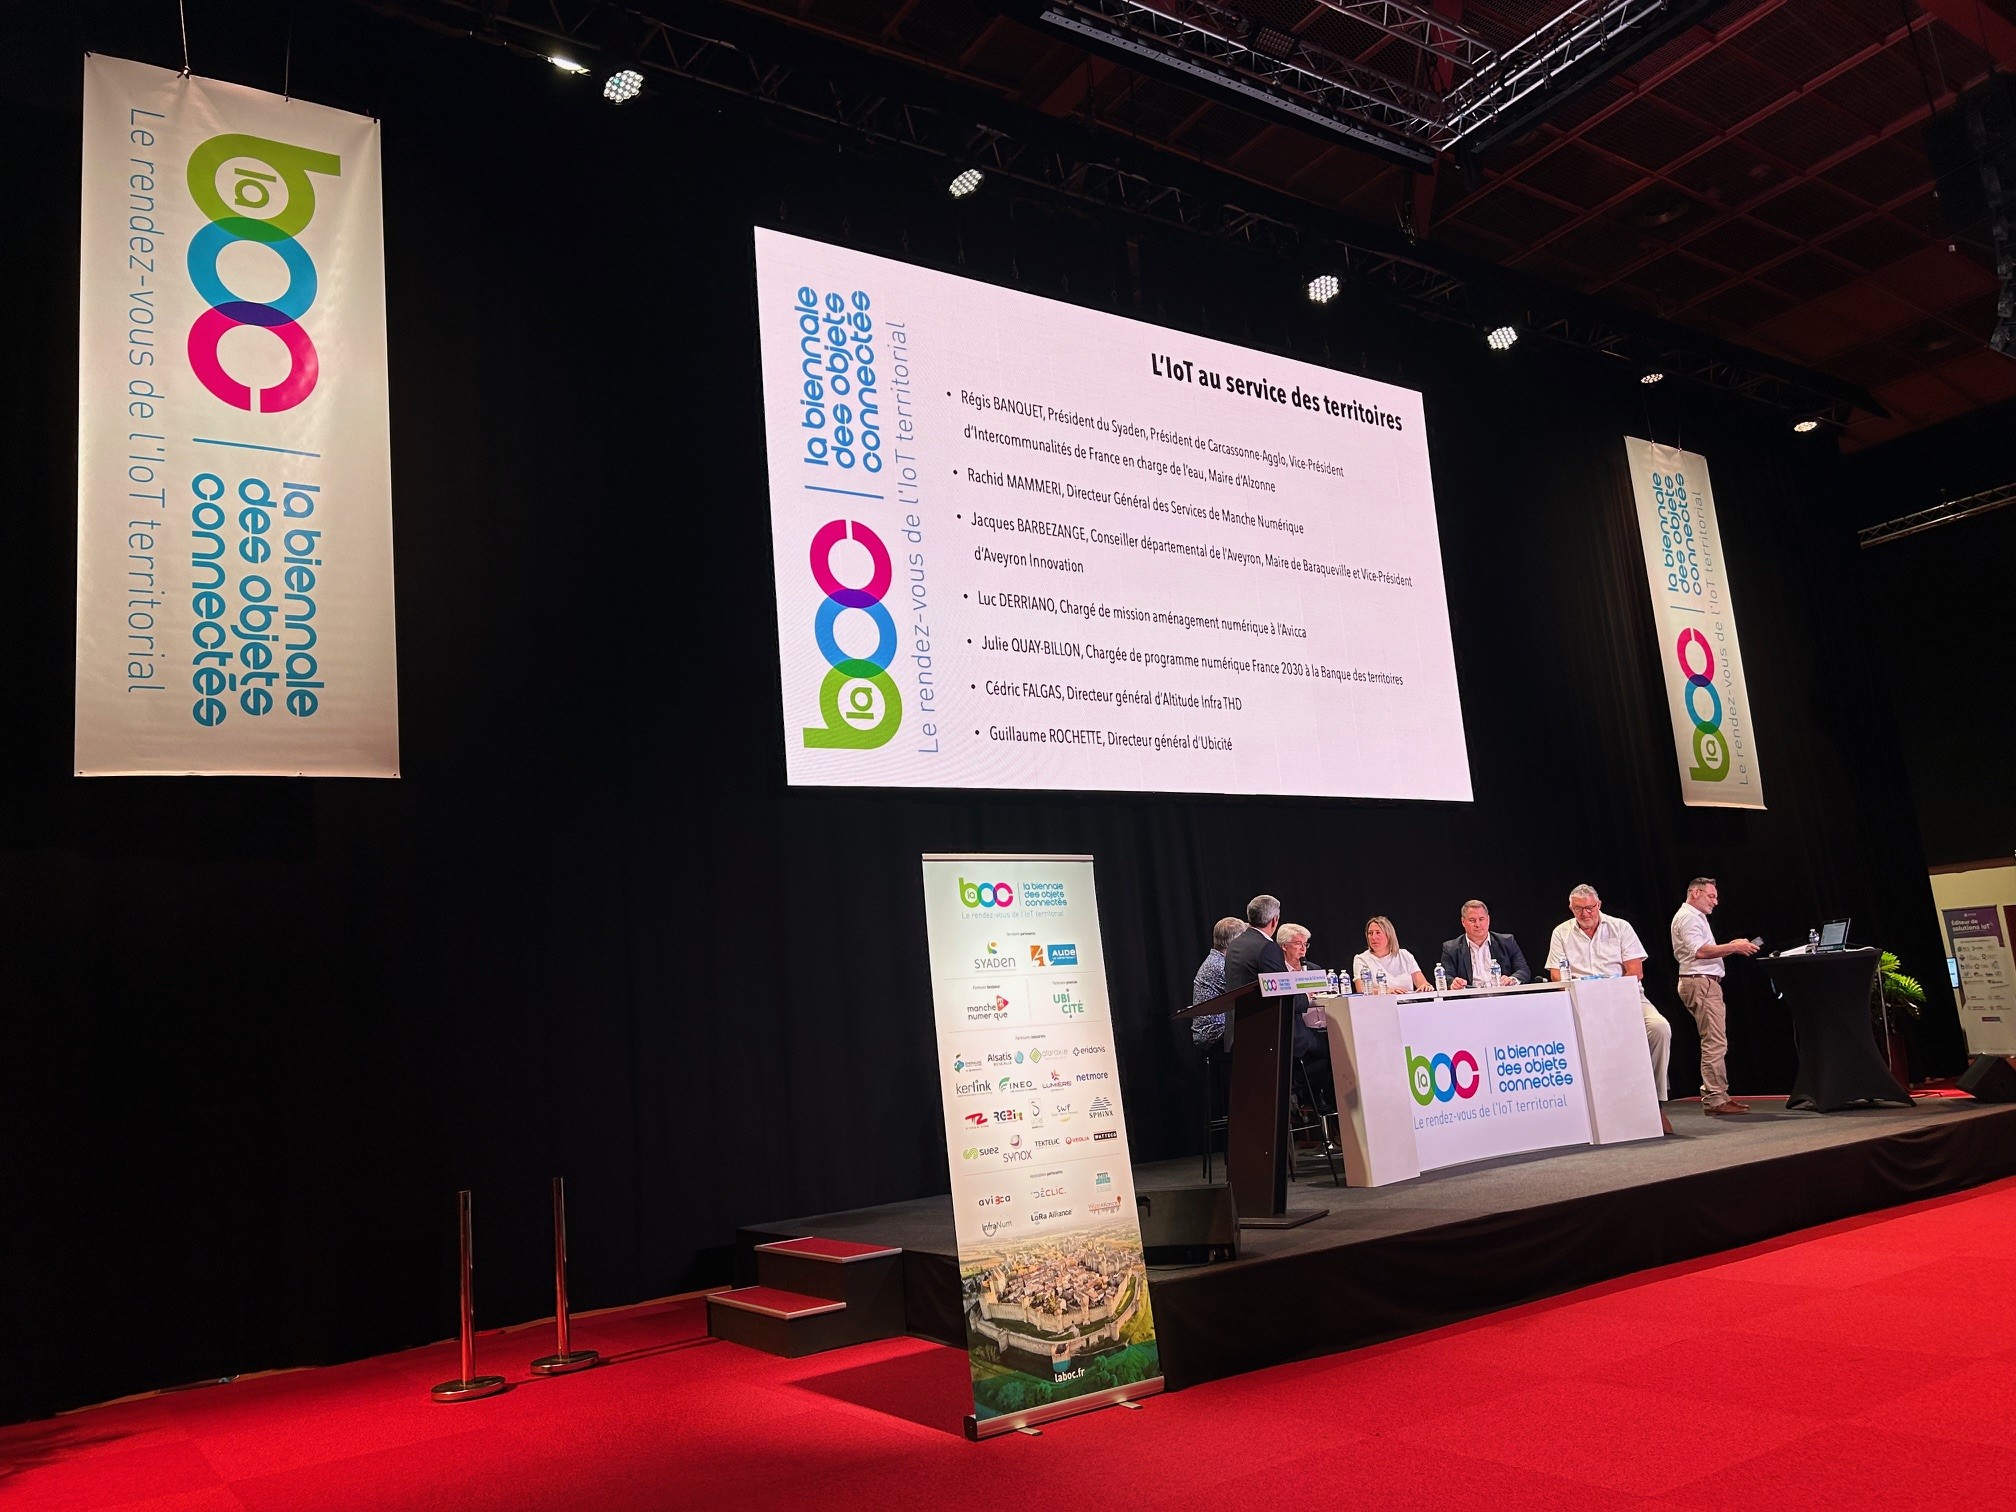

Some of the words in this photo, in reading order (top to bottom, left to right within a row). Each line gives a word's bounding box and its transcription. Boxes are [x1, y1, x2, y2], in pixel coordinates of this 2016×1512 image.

[130, 108, 165, 146] Le
[234, 168, 277, 209] la
[129, 158, 166, 366] rendez-vous
[186, 133, 341, 413] boc
[794, 286, 826, 430] biennale
[822, 292, 854, 396] objets
[128, 380, 165, 419] de
[885, 322, 914, 441] territorial
[1198, 369, 1221, 390] au
[1226, 376, 1287, 405] service
[1291, 386, 1320, 412] des
[1323, 395, 1403, 431] territoires
[804, 437, 829, 466] la
[831, 403, 856, 469] des
[961, 390, 991, 411] Régis
[993, 396, 1046, 422] BANQUET,
[1048, 407, 1095, 429] Président
[1097, 417, 1110, 432] du
[1111, 419, 1149, 441] Syaden,
[1150, 427, 1193, 448] Président
[1194, 436, 1206, 450] de
[1208, 438, 1288, 468] Carcassonne-Agglo,
[1288, 455, 1344, 477] Vice-Président
[129, 433, 166, 508] l'IoT
[894, 448, 919, 504] l'IoT
[1074, 444, 1087, 459] de
[1089, 447, 1120, 465] France
[1122, 456, 1135, 467] en
[1137, 455, 1168, 476] charge
[1170, 461, 1182, 476] de
[1208, 468, 1234, 485] Maire
[238, 478, 278, 563] des
[283, 482, 321, 519] la
[967, 467, 1004, 487] Rachid
[1007, 474, 1065, 498] MAMMERI,
[1066, 483, 1111, 504] Directeur
[1113, 491, 1151, 510] Général
[1152, 497, 1169, 513] des
[1170, 500, 1207, 519] Services
[1209, 506, 1220, 521] de
[1222, 509, 1256, 527] Manche
[1257, 515, 1304, 536] Numérique
[1652, 472, 1674, 563] biennale
[1664, 476, 1683, 545] objets
[901, 514, 922, 544] de
[971, 512, 1015, 533] Jacques
[1017, 518, 1089, 543] BARBEZANGE,
[1090, 528, 1139, 548] Conseiller
[1141, 535, 1208, 557] départemental
[1209, 545, 1221, 560] de
[1265, 554, 1289, 569] Maire
[1291, 557, 1302, 571] de
[1303, 559, 1351, 578] Baraqueville
[1352, 569, 1361, 580] et
[1360, 568, 1413, 587] Vice-Président
[1692, 491, 1712, 573] territorial
[1029, 553, 1084, 573] Innovation
[1667, 573, 1679, 592] la
[1679, 550, 1689, 594] des
[127, 520, 165, 694] territorial
[978, 591, 997, 607] Luc
[999, 593, 1058, 615] DERRIANO,
[1059, 599, 1096, 620] Chargé
[1098, 603, 1111, 618] de
[1113, 606, 1151, 622] mission
[1152, 611, 1220, 630] aménagement
[1221, 619, 1269, 637] numérique
[1270, 622, 1276, 635] à
[1705, 578, 1721, 615] l'IoT
[284, 529, 325, 717] biennale
[803, 519, 903, 750] boc
[909, 553, 935, 712] rendez-vous
[1714, 621, 1725, 642] de
[229, 575, 280, 716] objets
[982, 635, 1009, 652] Julie
[1011, 638, 1084, 660] QUAY-BILLON,
[1085, 644, 1127, 664] Chargée
[1129, 647, 1142, 663] de
[1144, 653, 1199, 669] programme
[1201, 656, 1251, 675] numérique
[1252, 659, 1280, 674] France
[1281, 662, 1304, 676] 2030
[1305, 664, 1311, 677] à
[1311, 664, 1320, 678] la
[1321, 665, 1351, 683] Banque
[1353, 668, 1367, 682] des
[1367, 671, 1404, 686] territoires
[846, 687, 875, 720] la
[985, 680, 1021, 697] Cédric
[1023, 682, 1065, 702] FALGAS,
[1066, 686, 1113, 702] Directeur
[1115, 689, 1152, 707] général
[1201, 695, 1222, 710] Infra
[1222, 696, 1242, 711] THD
[1676, 628, 1731, 783] boc
[1720, 648, 1745, 758] rendez-vous
[918, 724, 939, 753] Le
[989, 725, 1047, 743] Guillaume
[1049, 728, 1105, 747] ROCHETTE,
[1107, 731, 1152, 747] Directeur
[1154, 734, 1191, 752] général
[1705, 740, 1719, 762] la
[1739, 765, 1749, 785] Le
[959, 878, 1013, 908] boc
[1023, 882, 1031, 890] la
[1031, 882, 1064, 890] biennale
[1041, 890, 1065, 898] objets
[967, 1004, 997, 1013] manche
[987, 1052, 1012, 1062] Alsatis
[1494, 1046, 1506, 1061] la
[1507, 1041, 1565, 1059] biennale
[1497, 1062, 1522, 1077] des
[1524, 1057, 1567, 1075] objets
[955, 1079, 992, 1095] kerlink
[1076, 1072, 1109, 1082] netmore
[1405, 1046, 1481, 1107] boc
[1417, 1071, 1429, 1089] la
[1413, 1116, 1424, 1130] Le
[1425, 1109, 1478, 1127] rendez-vous
[1479, 1104, 1491, 1118] de
[1492, 1100, 1513, 1116] l'IoT
[1516, 1094, 1568, 1113] territorial
[1030, 1212, 1047, 1222] LoRa
[1048, 1209, 1072, 1219] Alliance
[1054, 1367, 1085, 1383] laboc.fr
